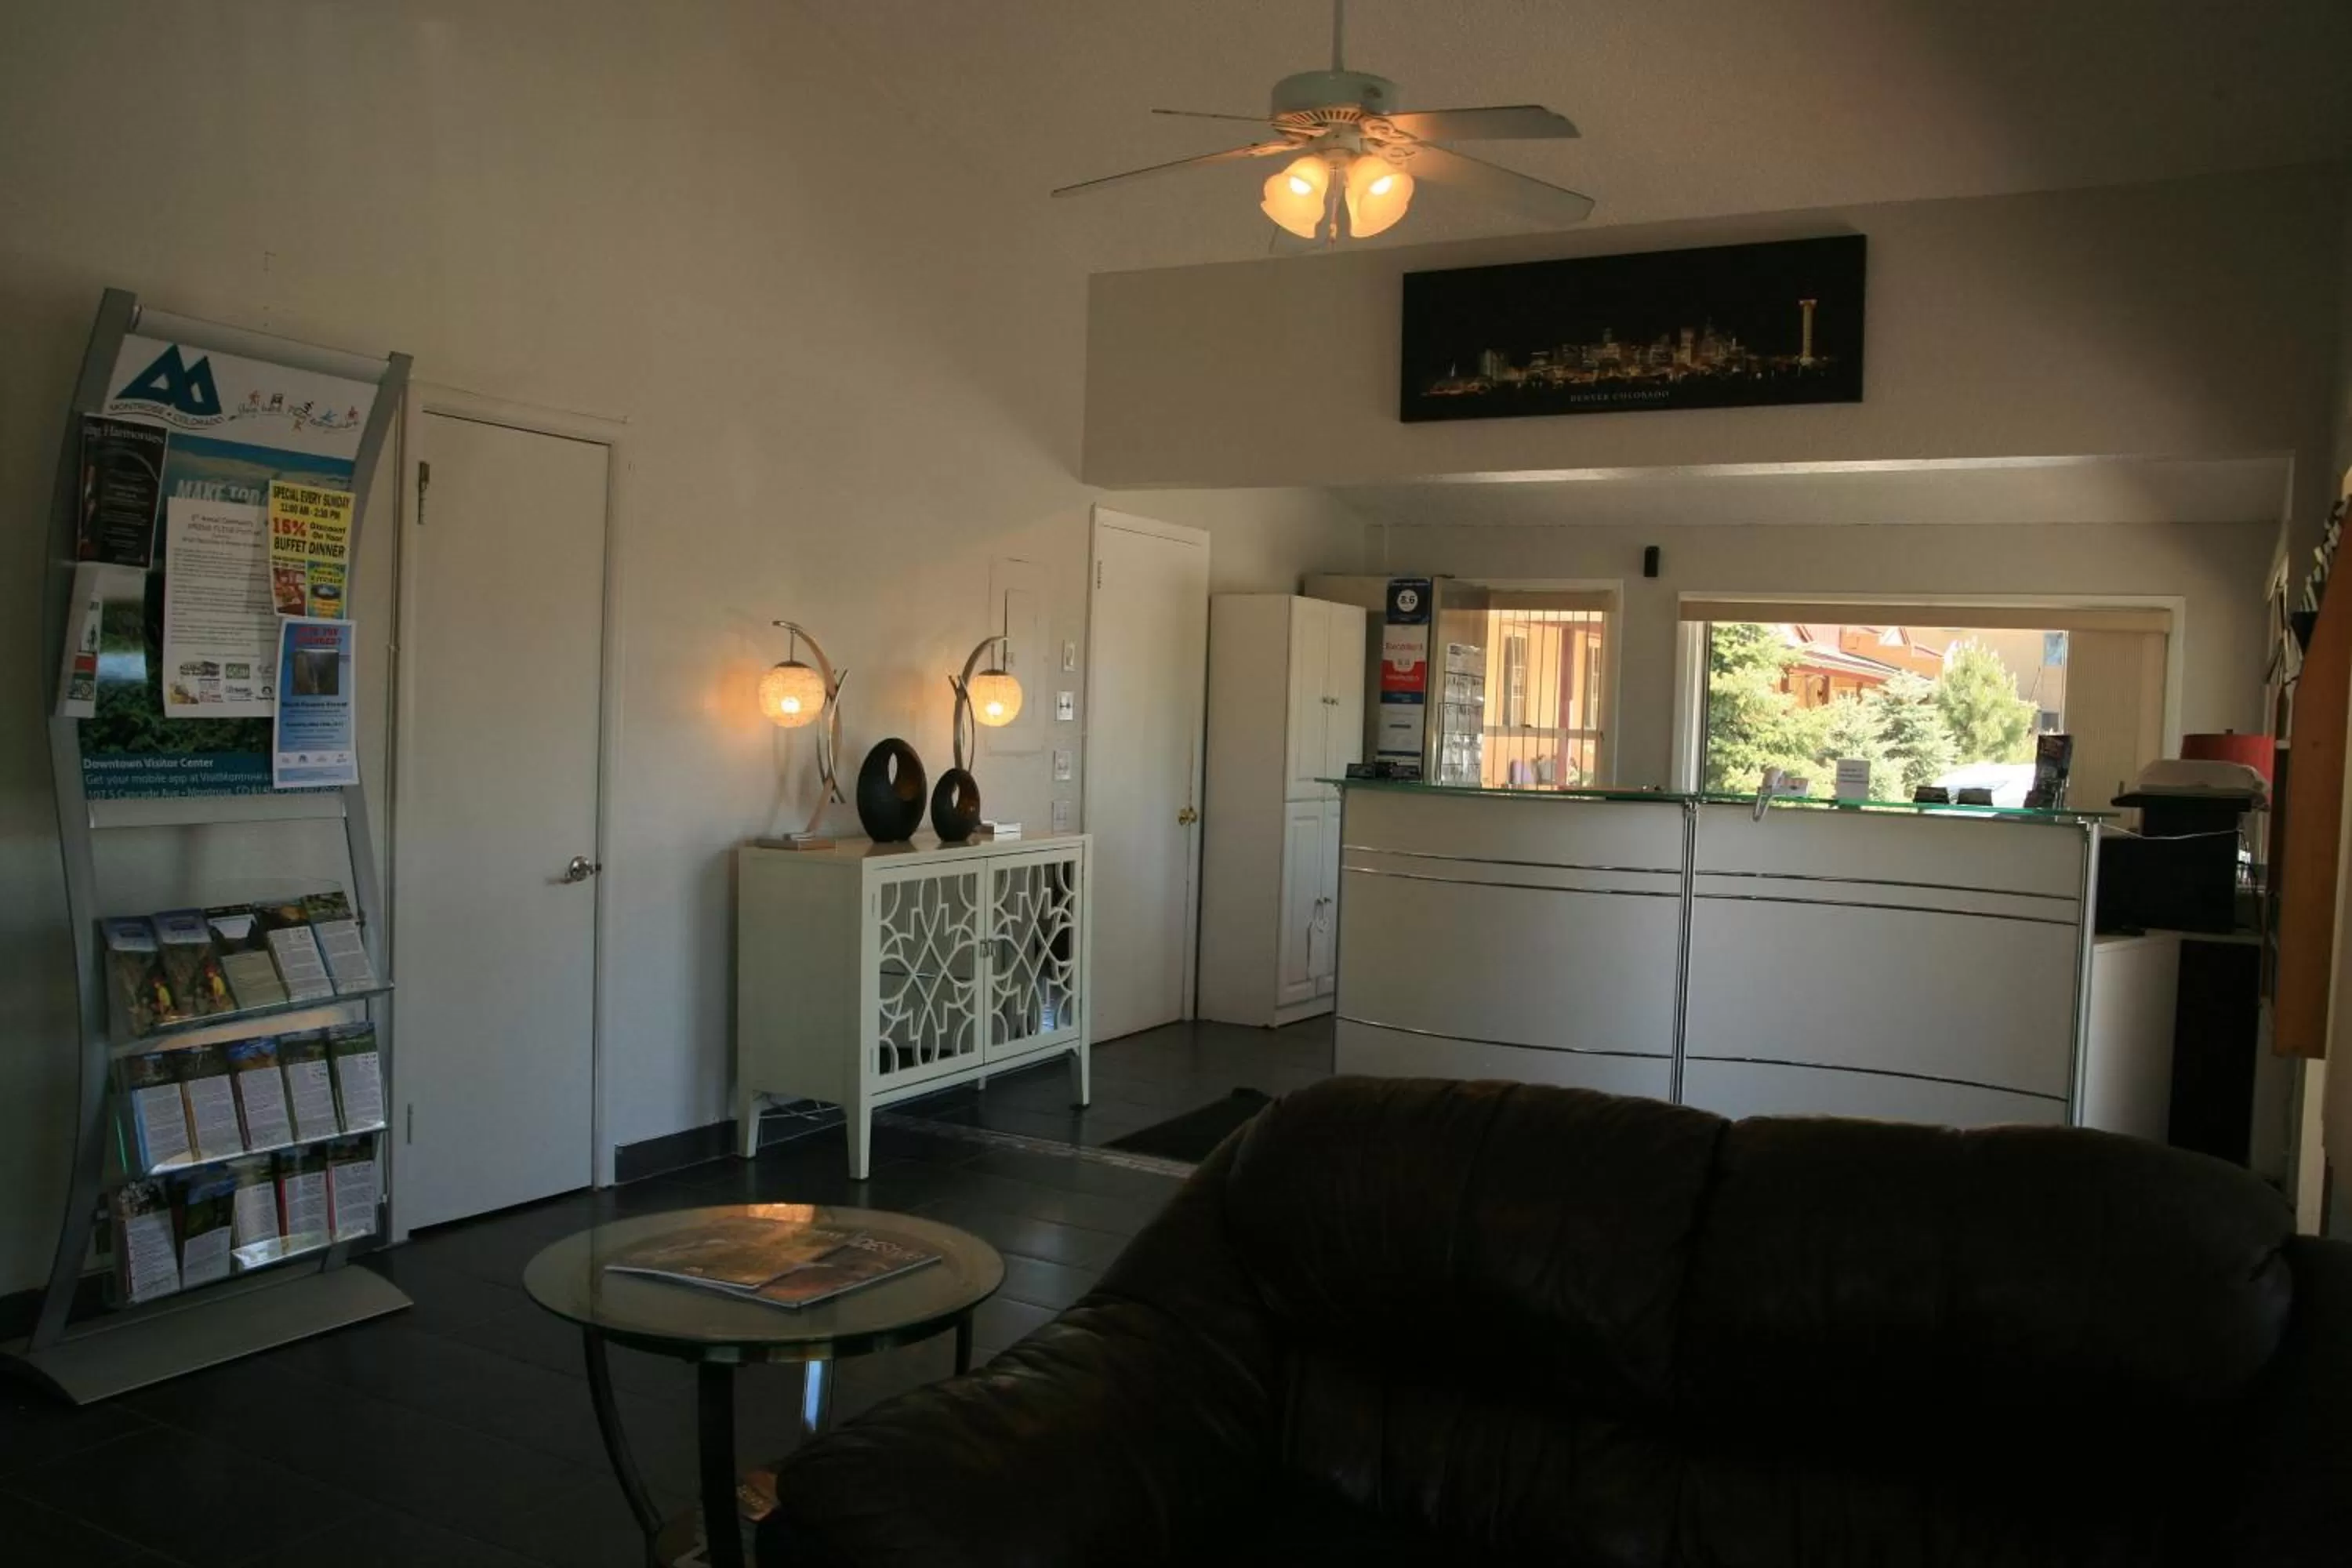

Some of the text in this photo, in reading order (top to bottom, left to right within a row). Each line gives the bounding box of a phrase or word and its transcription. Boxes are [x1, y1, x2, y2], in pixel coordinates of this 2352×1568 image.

[1570, 390, 1669, 402] DENVER COLORADO
[109, 402, 226, 426] MONTROSE COLORADO
[176, 479, 268, 506] MAKE TOD
[273, 485, 350, 509] SPECIAL EVERY SUNDAY
[299, 504, 310, 515] AM
[329, 510, 341, 521] PM
[274, 536, 307, 553] BUFFET
[308, 541, 346, 558] DINNER
[83, 757, 214, 769] Downtown Visitor Center
[85, 774, 103, 785] Get
[107, 775, 129, 786] your
[132, 774, 167, 784] mobile
[169, 774, 187, 786] app
